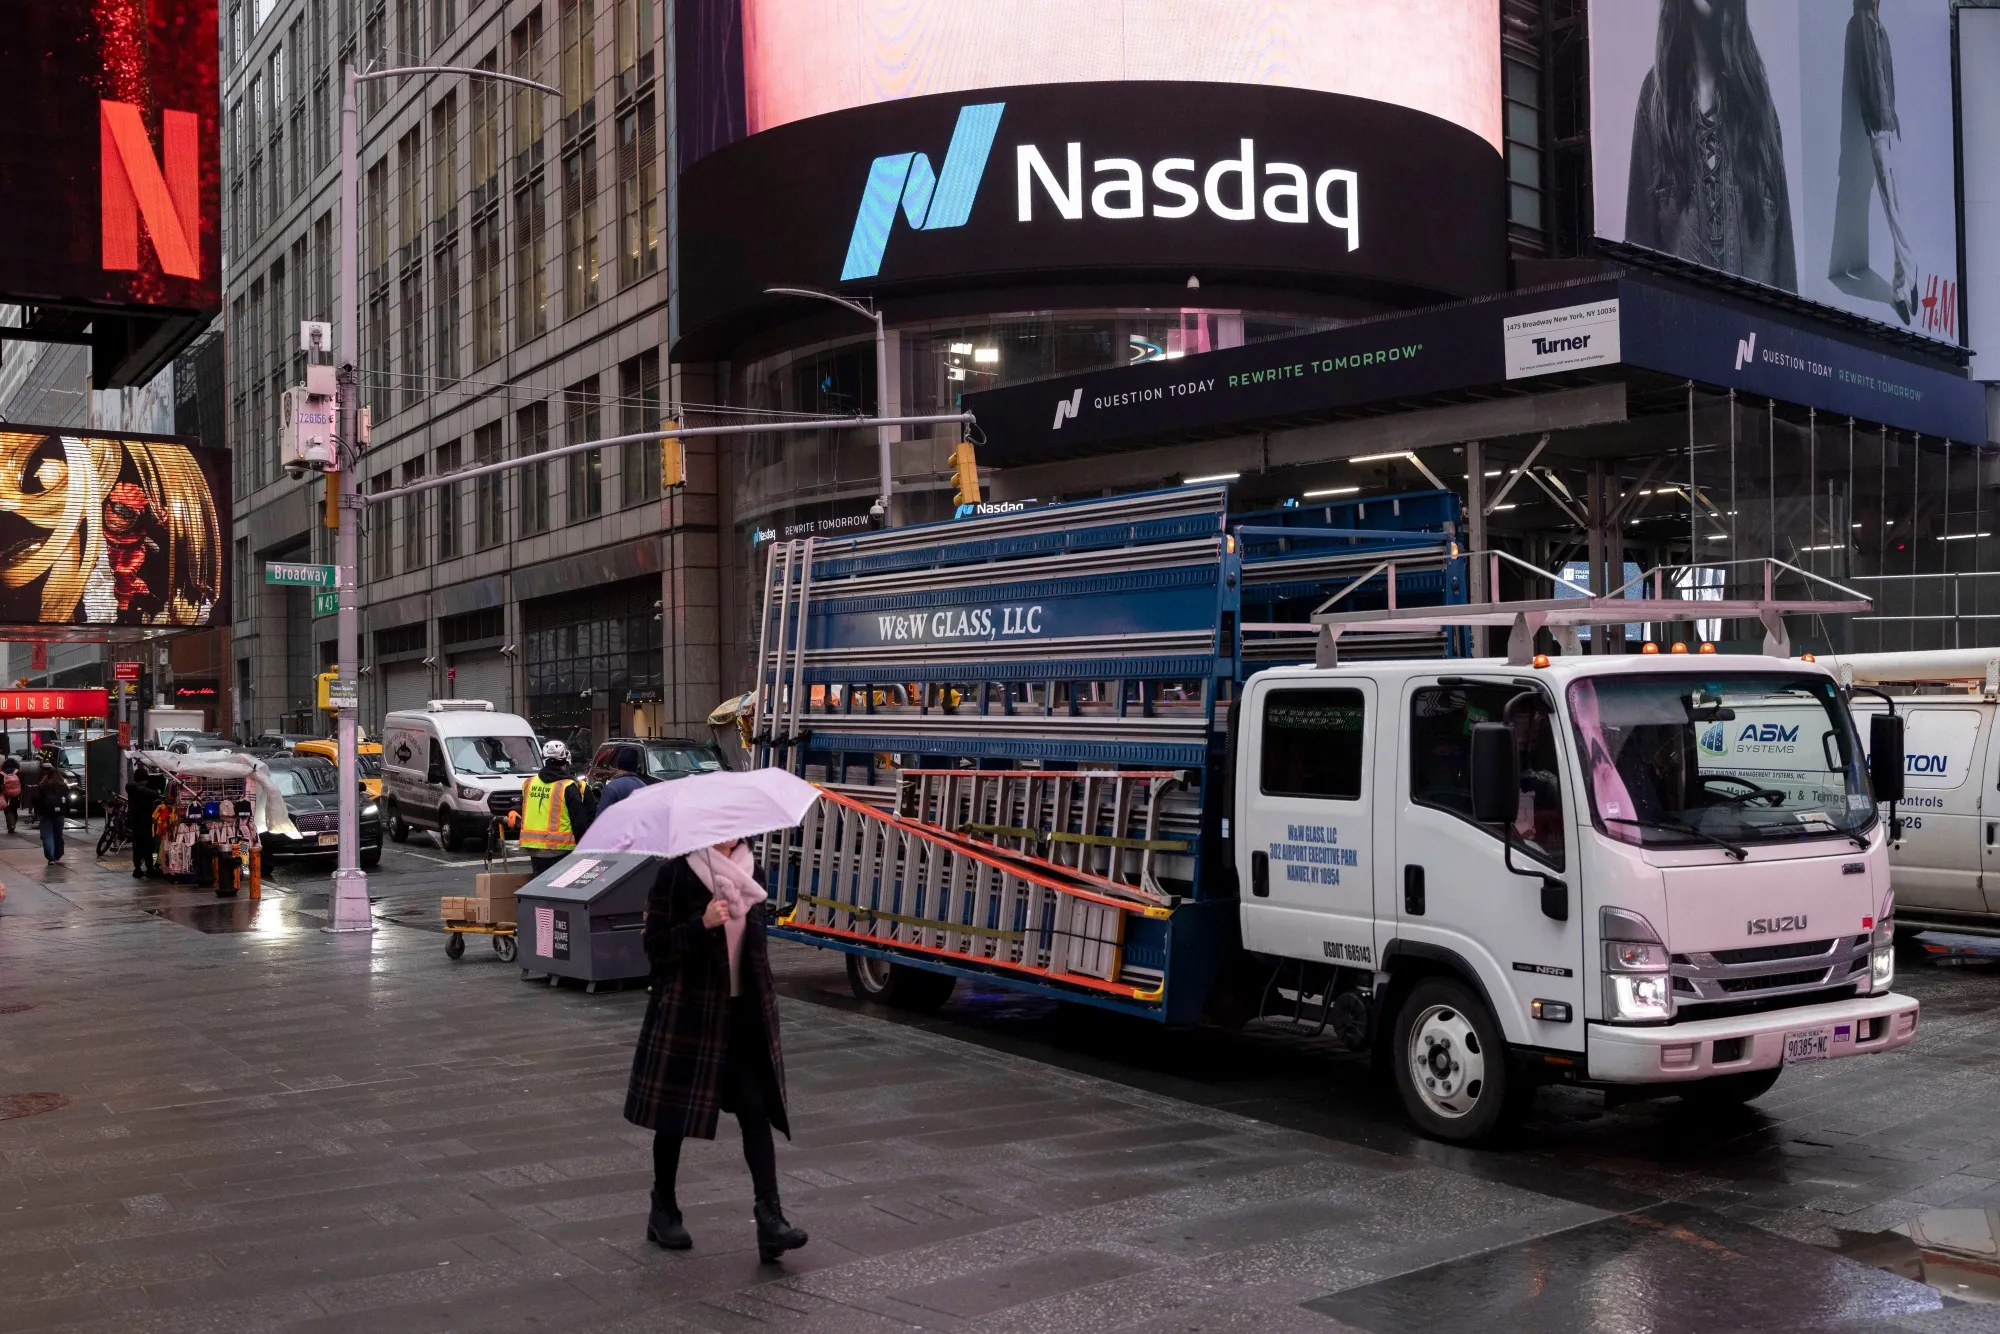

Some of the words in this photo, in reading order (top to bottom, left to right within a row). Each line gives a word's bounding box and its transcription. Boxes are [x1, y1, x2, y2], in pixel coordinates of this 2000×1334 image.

[1016, 137, 1360, 253] Nasdaq
[1921, 273, 1956, 340] H&M
[1506, 324, 1521, 332] 1475
[1522, 318, 1553, 330] Broadway
[1569, 312, 1585, 321] York,
[1586, 309, 1596, 317] NY
[1597, 306, 1617, 316] 10036
[1532, 334, 1591, 355] Turner
[1762, 349, 1805, 371] QUESTION
[1807, 361, 1833, 378] TODAY
[1838, 369, 1875, 389] REWRITE
[1094, 388, 1163, 409] QUESTION
[1169, 378, 1216, 397] TODAY
[1228, 364, 1305, 388] REWRITE
[299, 413, 327, 425] 726156
[977, 501, 1024, 514] Nasdaq
[759, 528, 776, 541] Nasdaq
[785, 521, 815, 536] REWRITE
[817, 515, 869, 530] TOMORROW
[274, 565, 328, 586] Broadway
[318, 596, 324, 612] W
[324, 595, 333, 611] 43
[878, 613, 929, 641] W&W
[931, 608, 996, 641] GLASS,
[1002, 605, 1042, 635] LLC
[1, 697, 65, 710] DINER
[1738, 723, 1800, 743] ABM
[1736, 744, 1795, 754] SYSTEMS
[1772, 772, 1795, 780] SYSTEMS,
[1797, 790, 1805, 800] &
[1896, 796, 1944, 808] ontrols
[1287, 824, 1305, 841] W&W
[1305, 825, 1326, 845] GLASS,
[1326, 826, 1338, 844] LLC
[1269, 843, 1282, 860] 302
[1282, 844, 1308, 862] AIRPORT
[1308, 846, 1340, 865] EXECUTIVE
[1340, 848, 1358, 867] PARK
[1286, 864, 1311, 885] NANUET,
[1311, 866, 1319, 884] NY
[1320, 867, 1340, 886] 10954
[555, 920, 567, 930] TIMES
[1747, 914, 1807, 936] ISUZU
[554, 930, 568, 942] SQUARE
[1323, 940, 1344, 960] USDOT
[1344, 943, 1371, 963] 1685143
[1536, 965, 1565, 976] NRR
